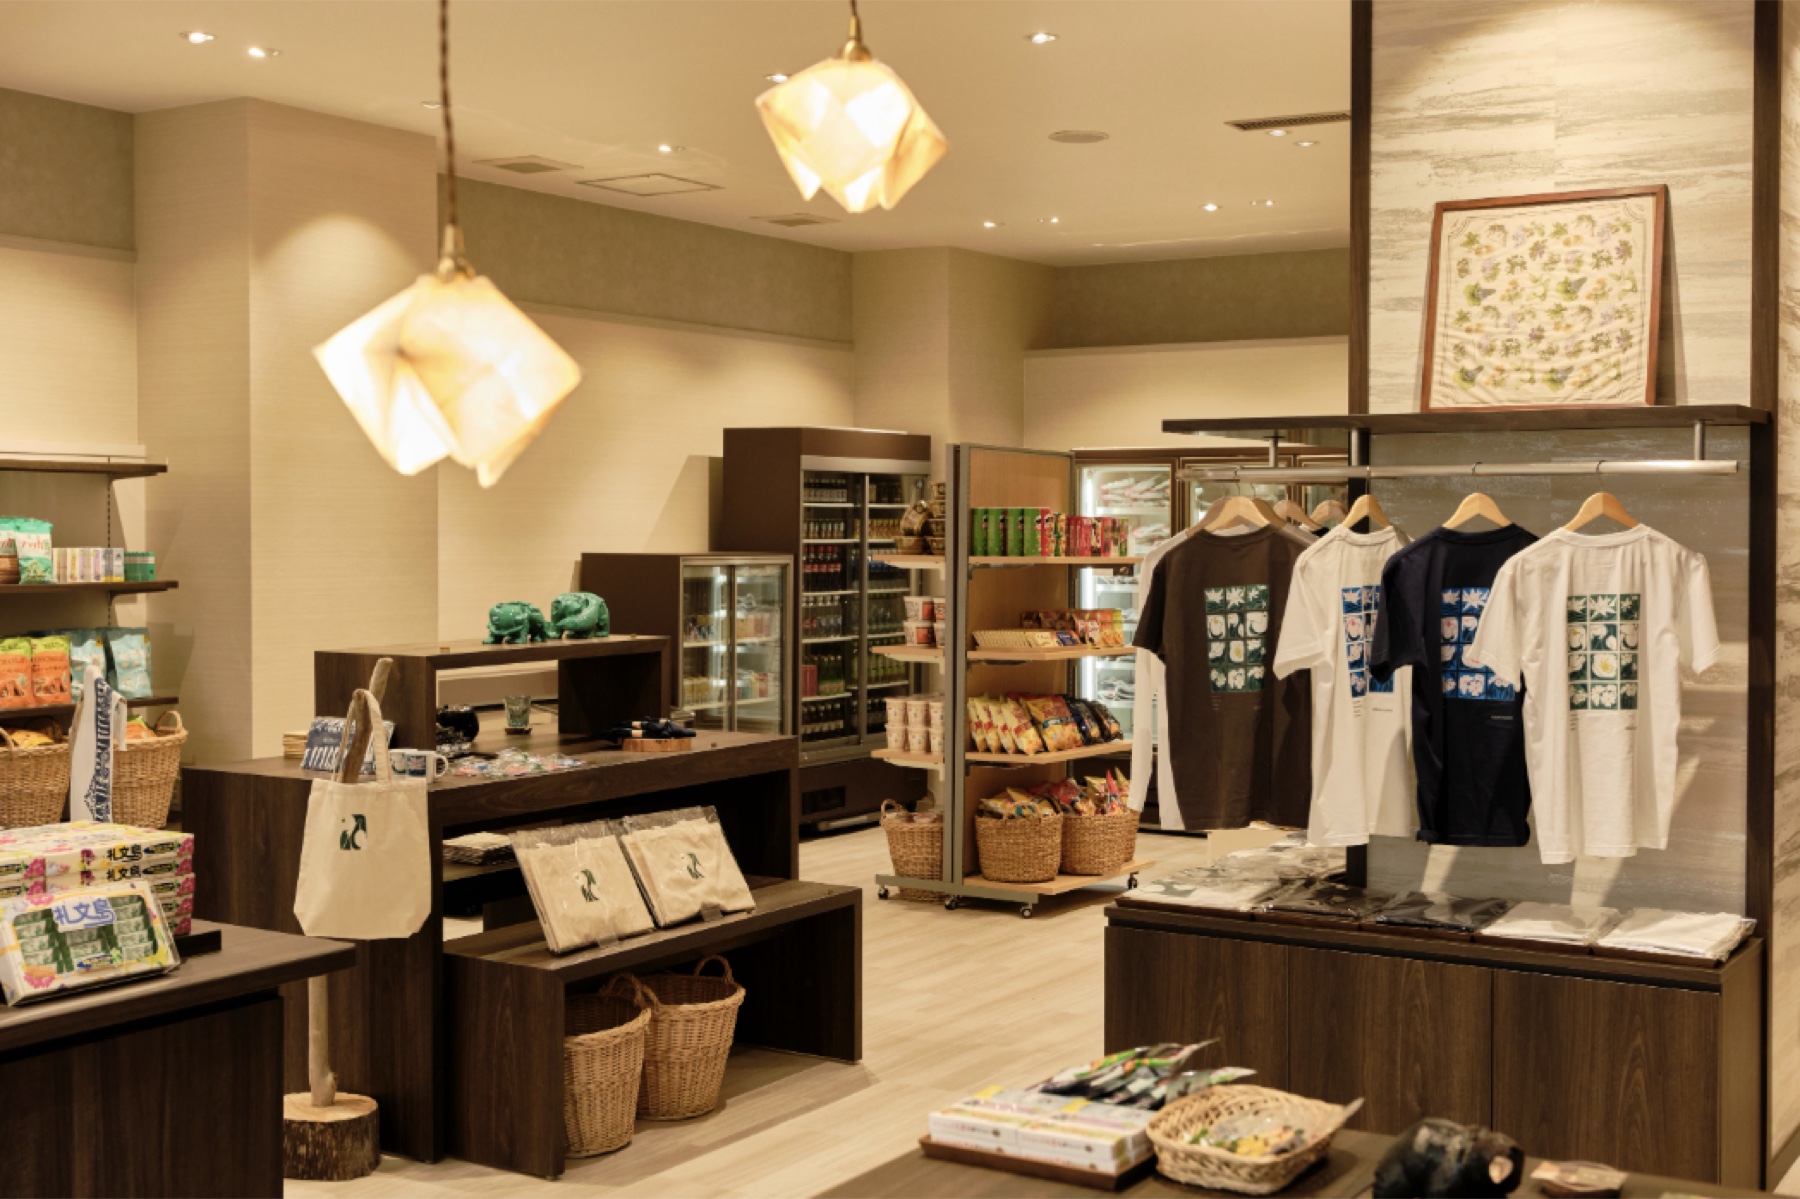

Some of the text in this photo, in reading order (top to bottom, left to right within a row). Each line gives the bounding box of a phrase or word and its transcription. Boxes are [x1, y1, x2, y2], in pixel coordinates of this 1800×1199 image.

[106, 843, 143, 862] 礼文島
[53, 897, 116, 927] 礼文島
